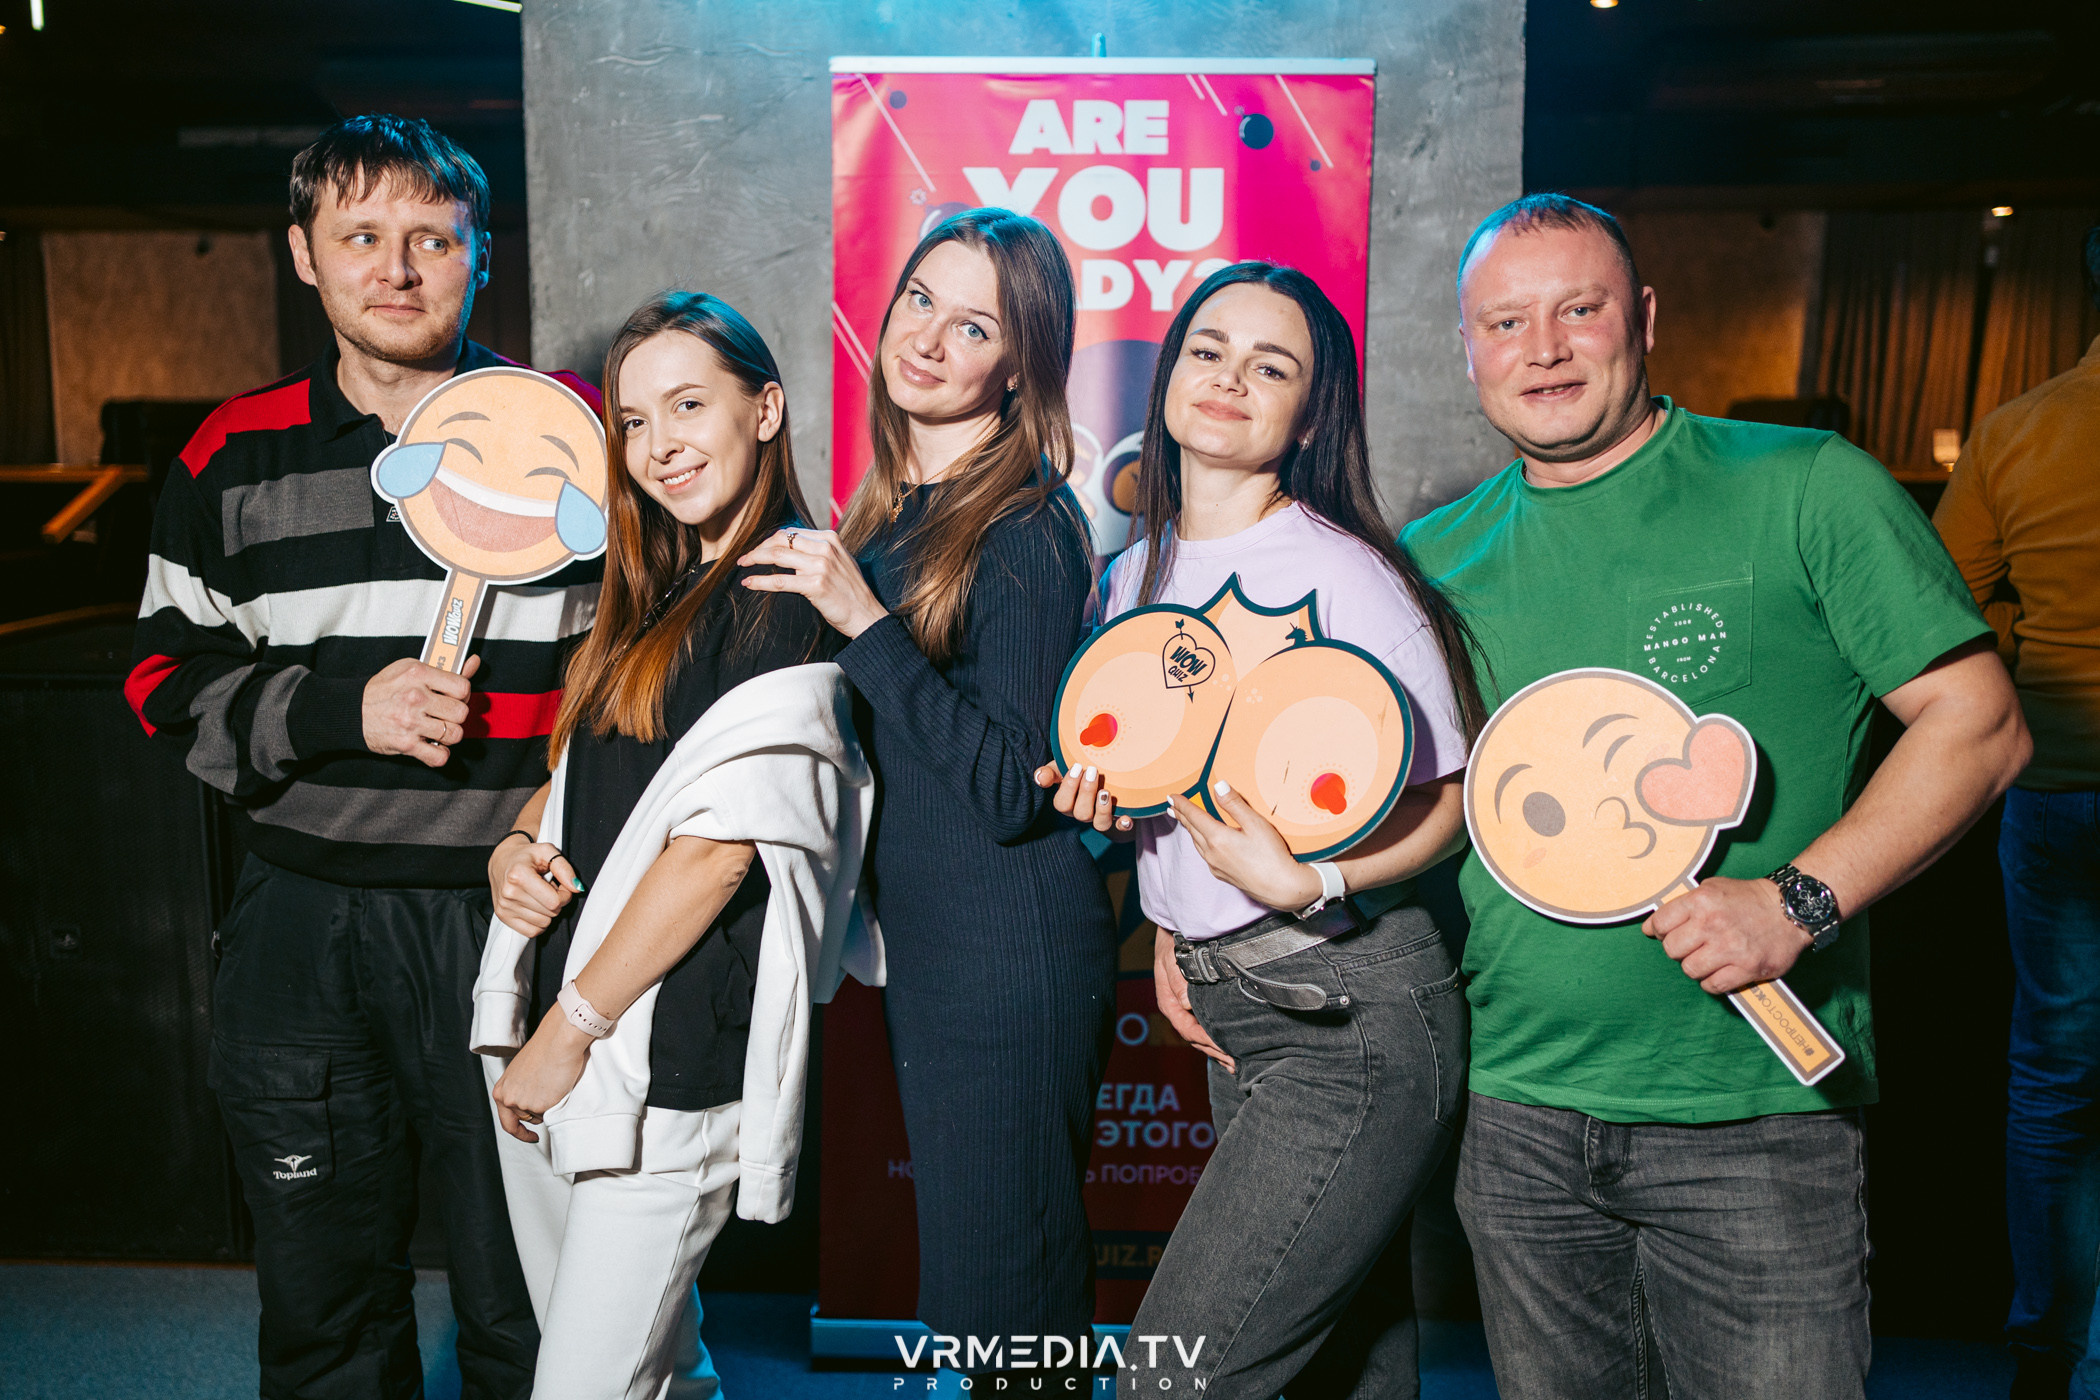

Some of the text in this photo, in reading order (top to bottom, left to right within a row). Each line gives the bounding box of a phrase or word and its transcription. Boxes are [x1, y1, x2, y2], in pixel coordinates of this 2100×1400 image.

[1008, 99, 1169, 155] ARE
[962, 165, 1225, 252] YOU
[1646, 602, 1725, 640] ESTABLISHED
[1643, 631, 1727, 652] MANGO MAN
[1168, 666, 1188, 682] QUIZ
[1170, 646, 1207, 676] WOW
[1648, 645, 1721, 683] BARCELONA
[1095, 1082, 1181, 1116] ЕГДА
[1095, 1120, 1217, 1150] ЭТОГО
[1101, 1163, 1203, 1186] ПОПРОБ
